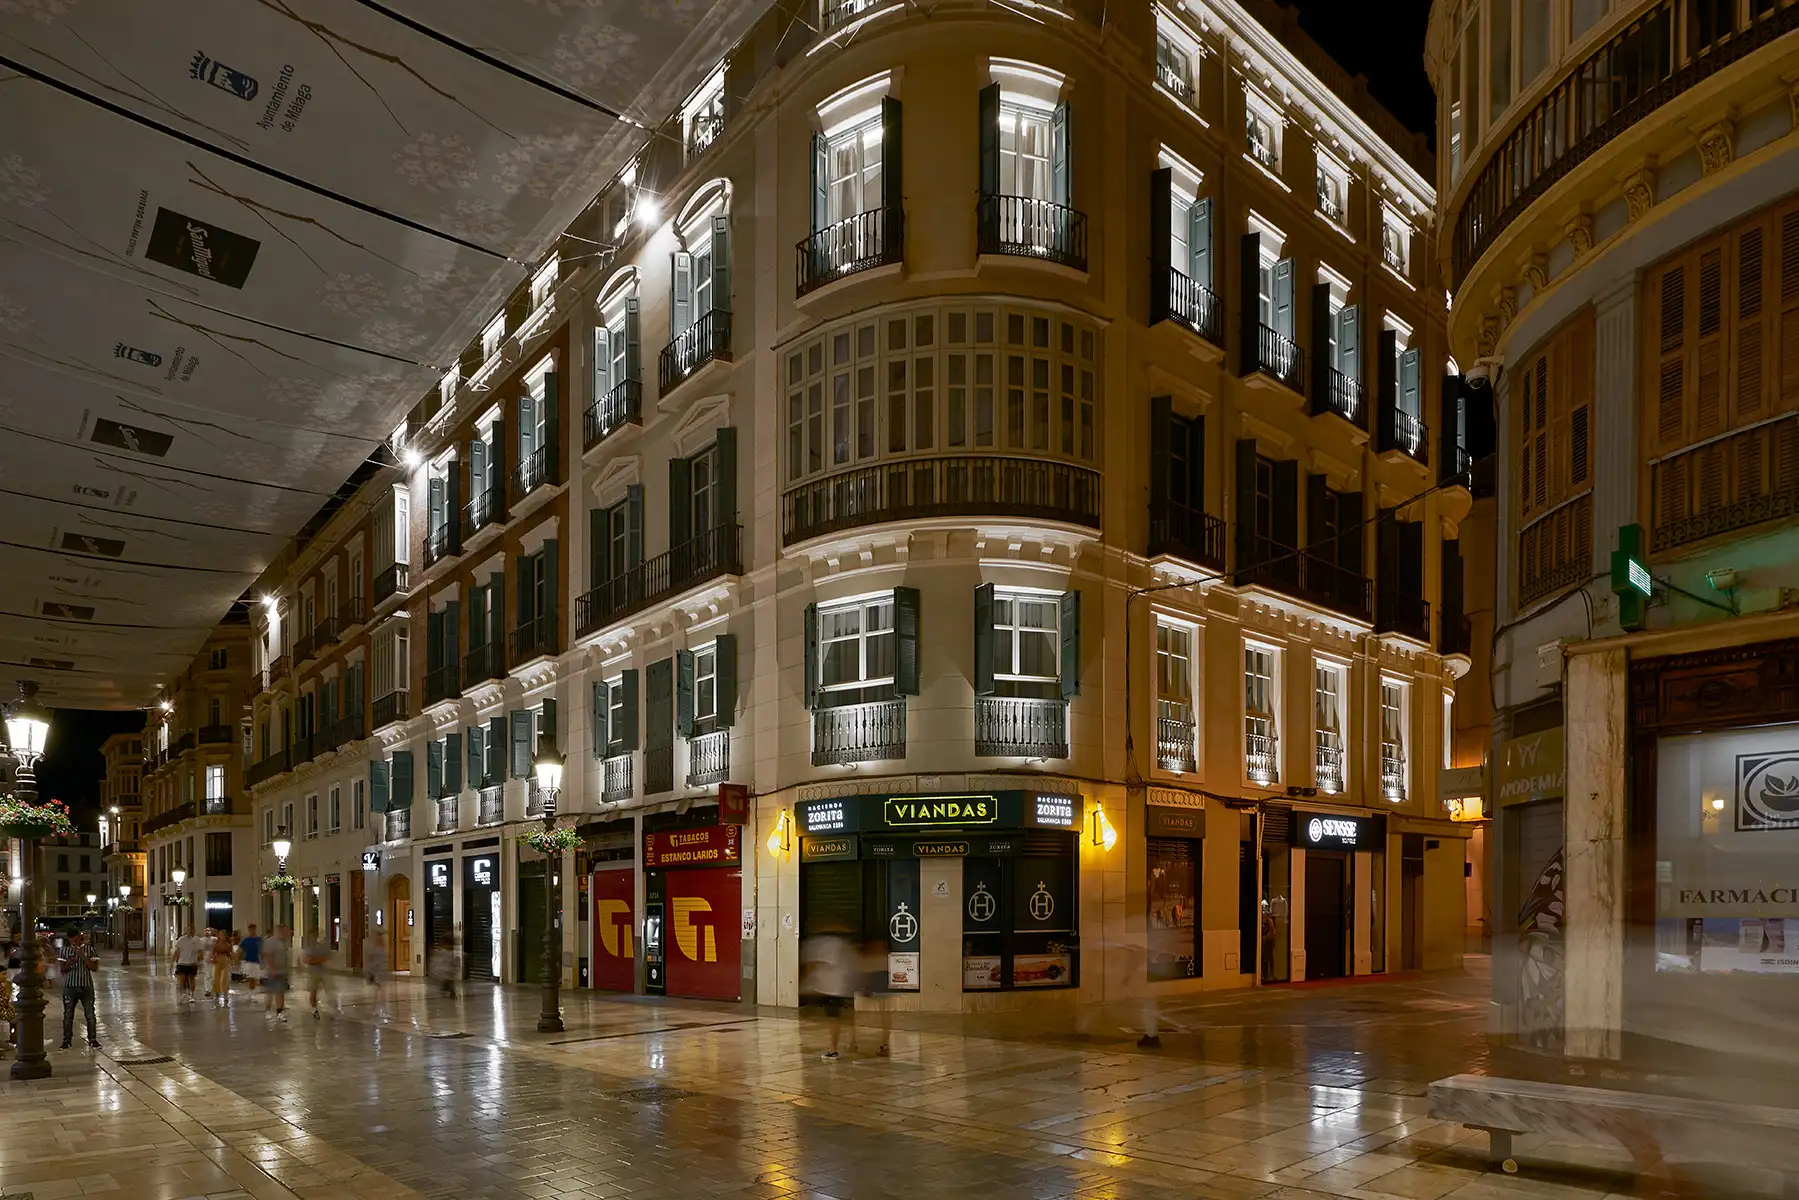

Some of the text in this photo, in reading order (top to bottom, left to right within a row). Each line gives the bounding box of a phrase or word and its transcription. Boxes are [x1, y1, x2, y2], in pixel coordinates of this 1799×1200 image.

[256, 63, 295, 131] Ayuntamiento
[279, 82, 312, 133] de Málaga
[894, 802, 987, 819] VIANDAS
[1161, 816, 1193, 827] VIANDAS
[1322, 819, 1357, 837] SENSSE
[679, 832, 709, 843] TABACOS
[810, 843, 847, 853] VIANDAS
[918, 845, 965, 853] VIANDAS
[661, 849, 718, 863] ESTANCO LARIOS
[1679, 888, 1799, 904] FARMACI
